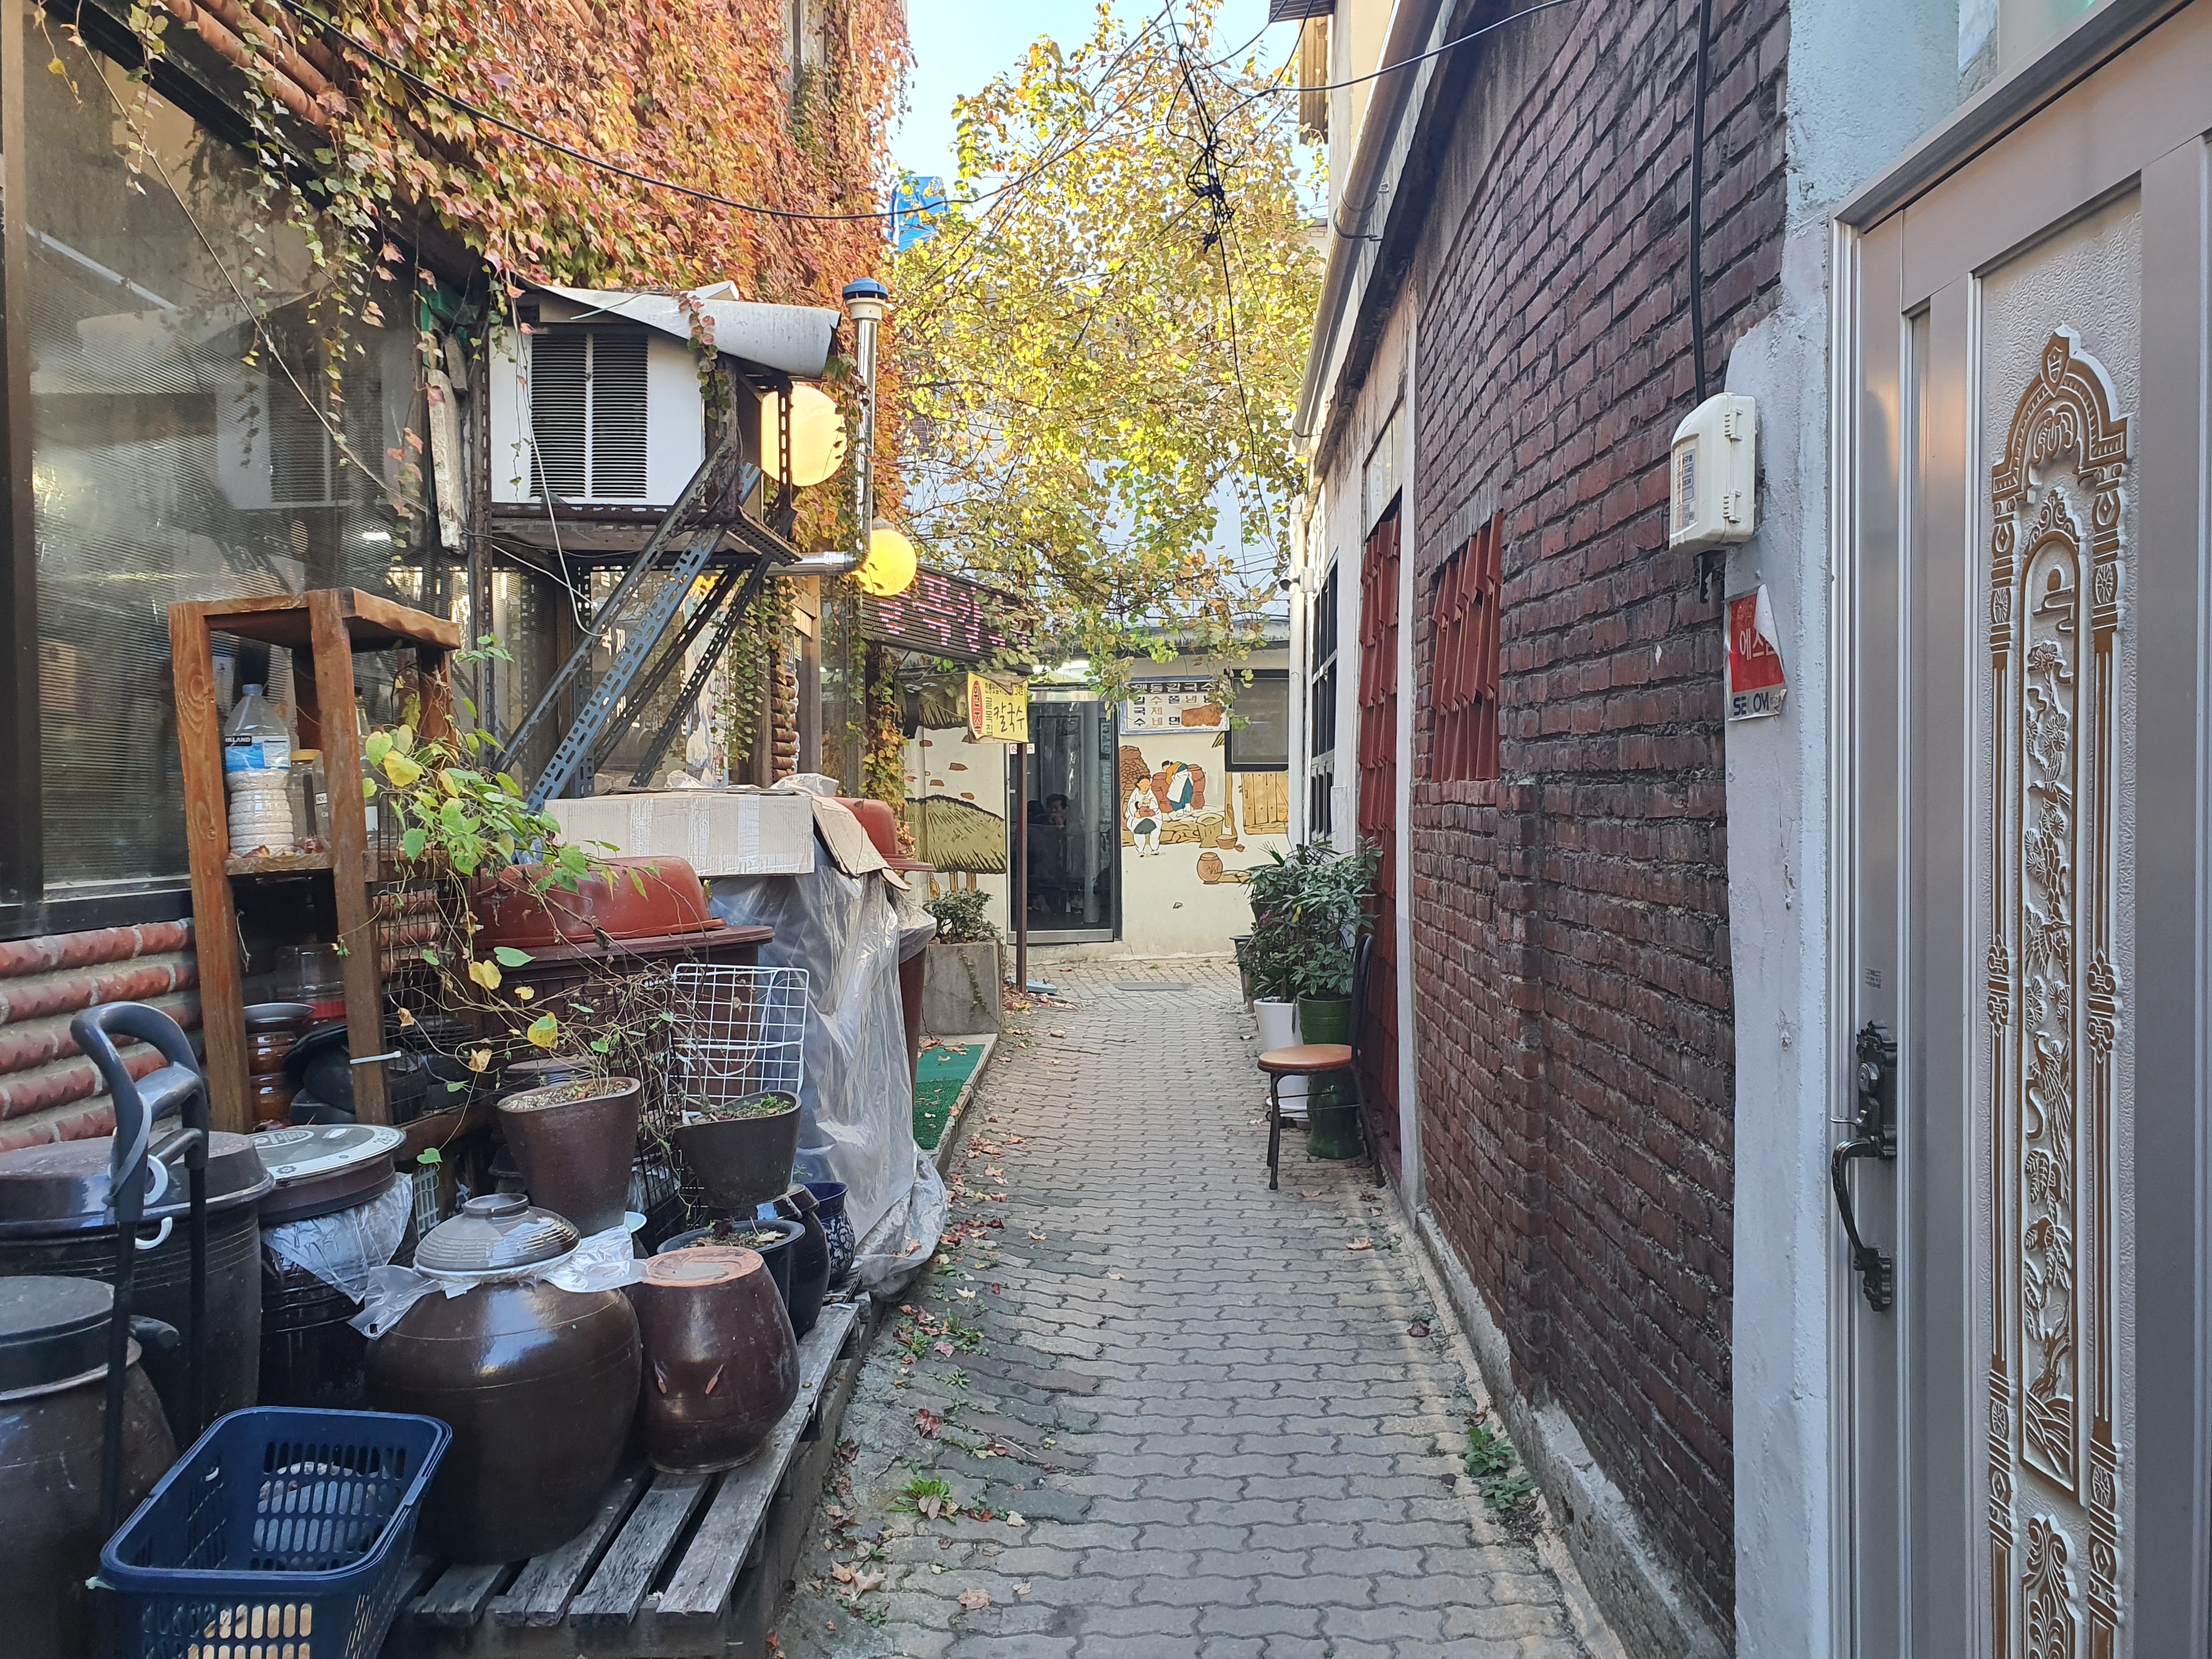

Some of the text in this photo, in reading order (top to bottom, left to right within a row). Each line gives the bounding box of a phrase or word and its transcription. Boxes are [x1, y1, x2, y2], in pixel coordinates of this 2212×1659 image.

[1739, 628, 1776, 661] 에스
[973, 685, 981, 730] 원조
[994, 702, 1025, 733] 칼국수
[1150, 696, 1163, 726] 수제비
